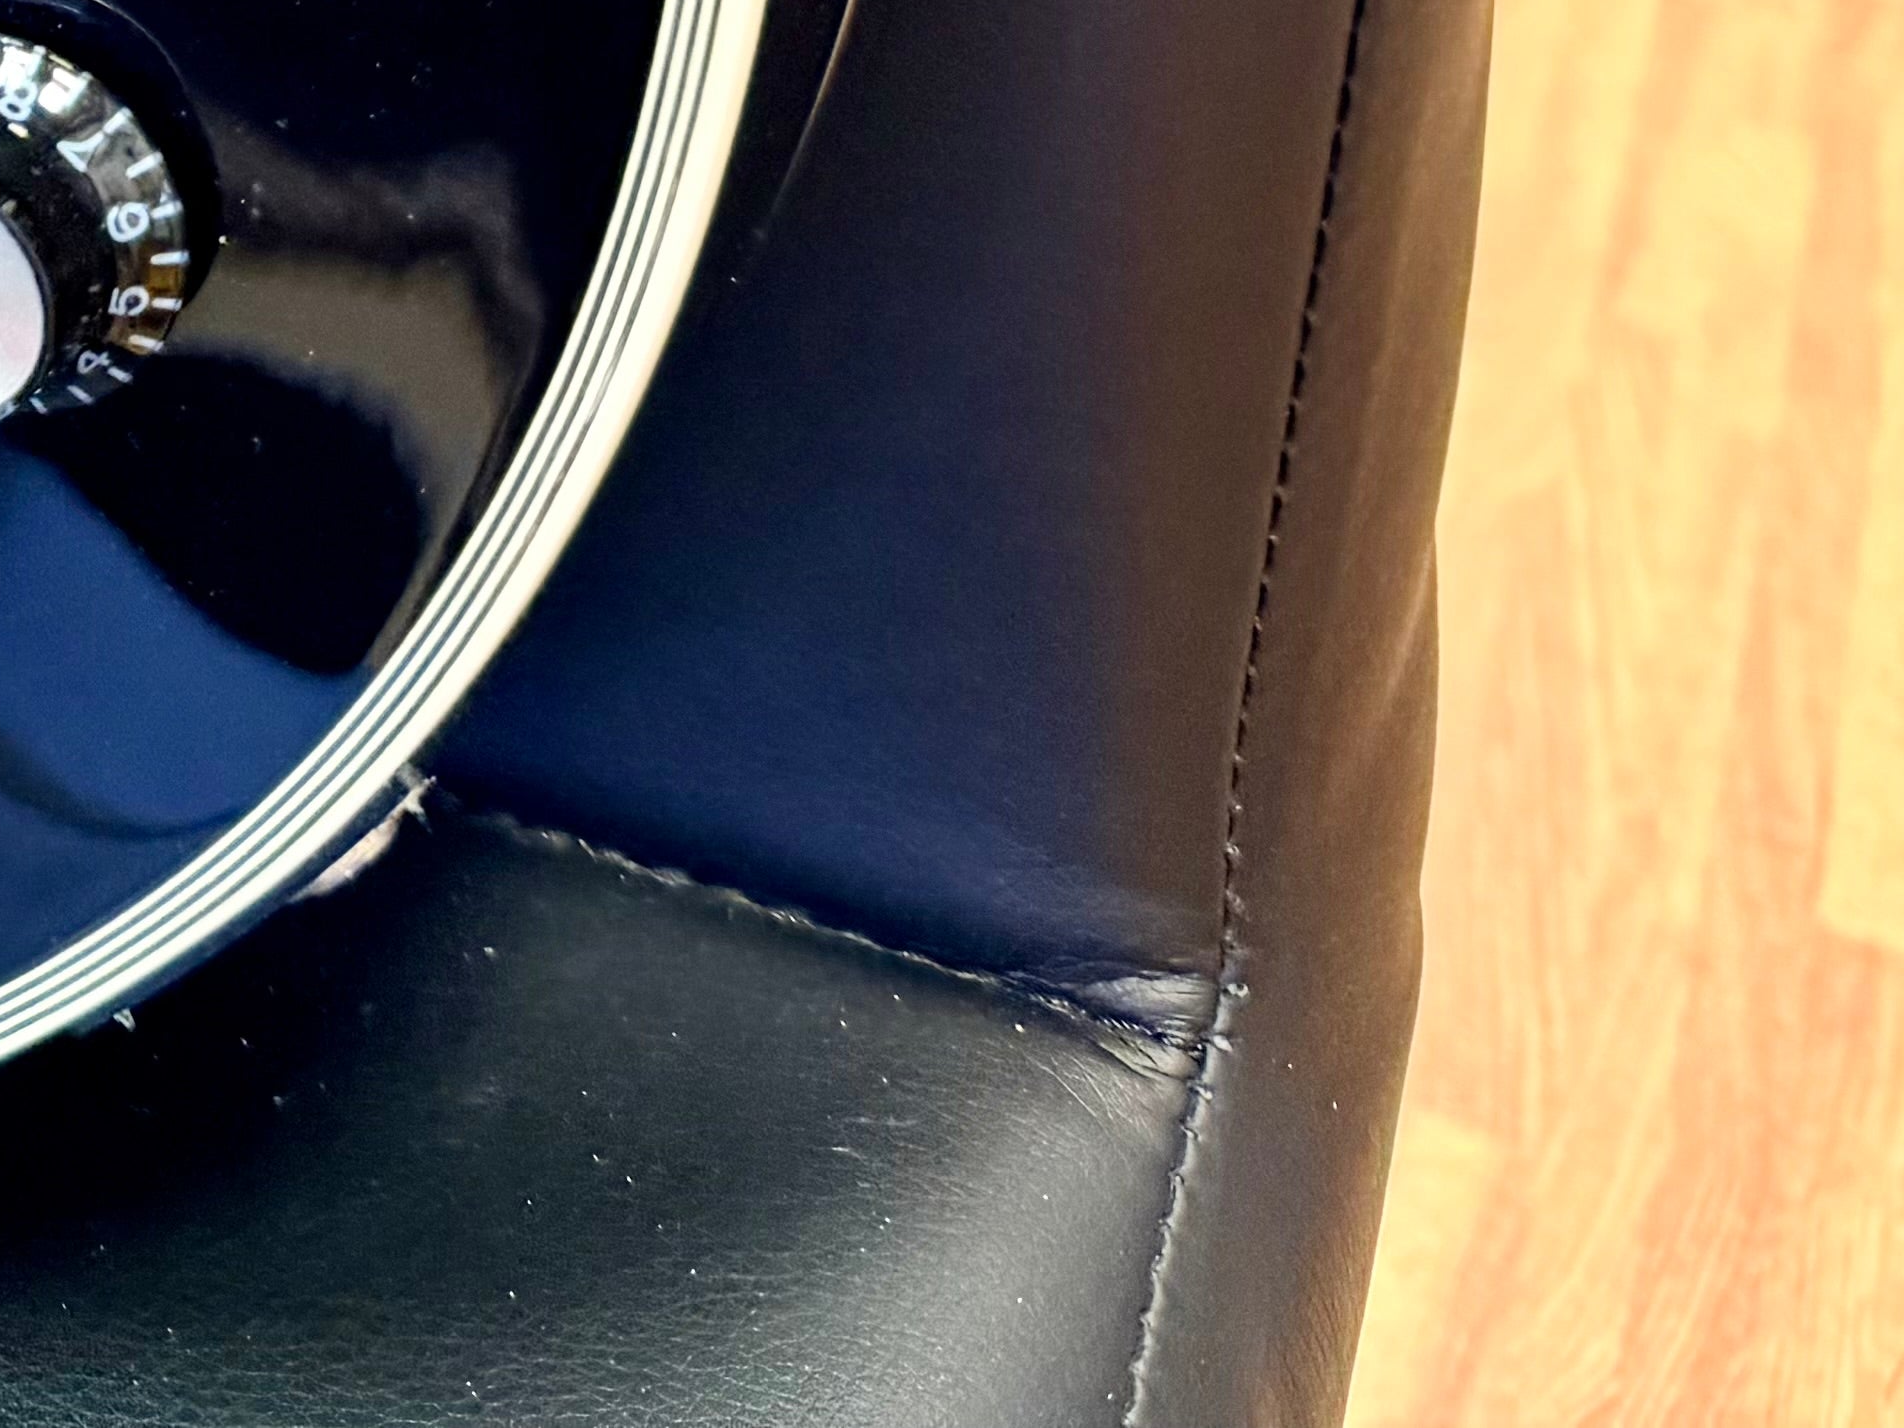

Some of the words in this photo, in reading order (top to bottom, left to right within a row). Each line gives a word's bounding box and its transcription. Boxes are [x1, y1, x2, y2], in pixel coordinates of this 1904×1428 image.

[56, 129, 105, 173] 7
[106, 201, 151, 242] 6
[108, 286, 150, 316] 5
[76, 350, 112, 375] 4
